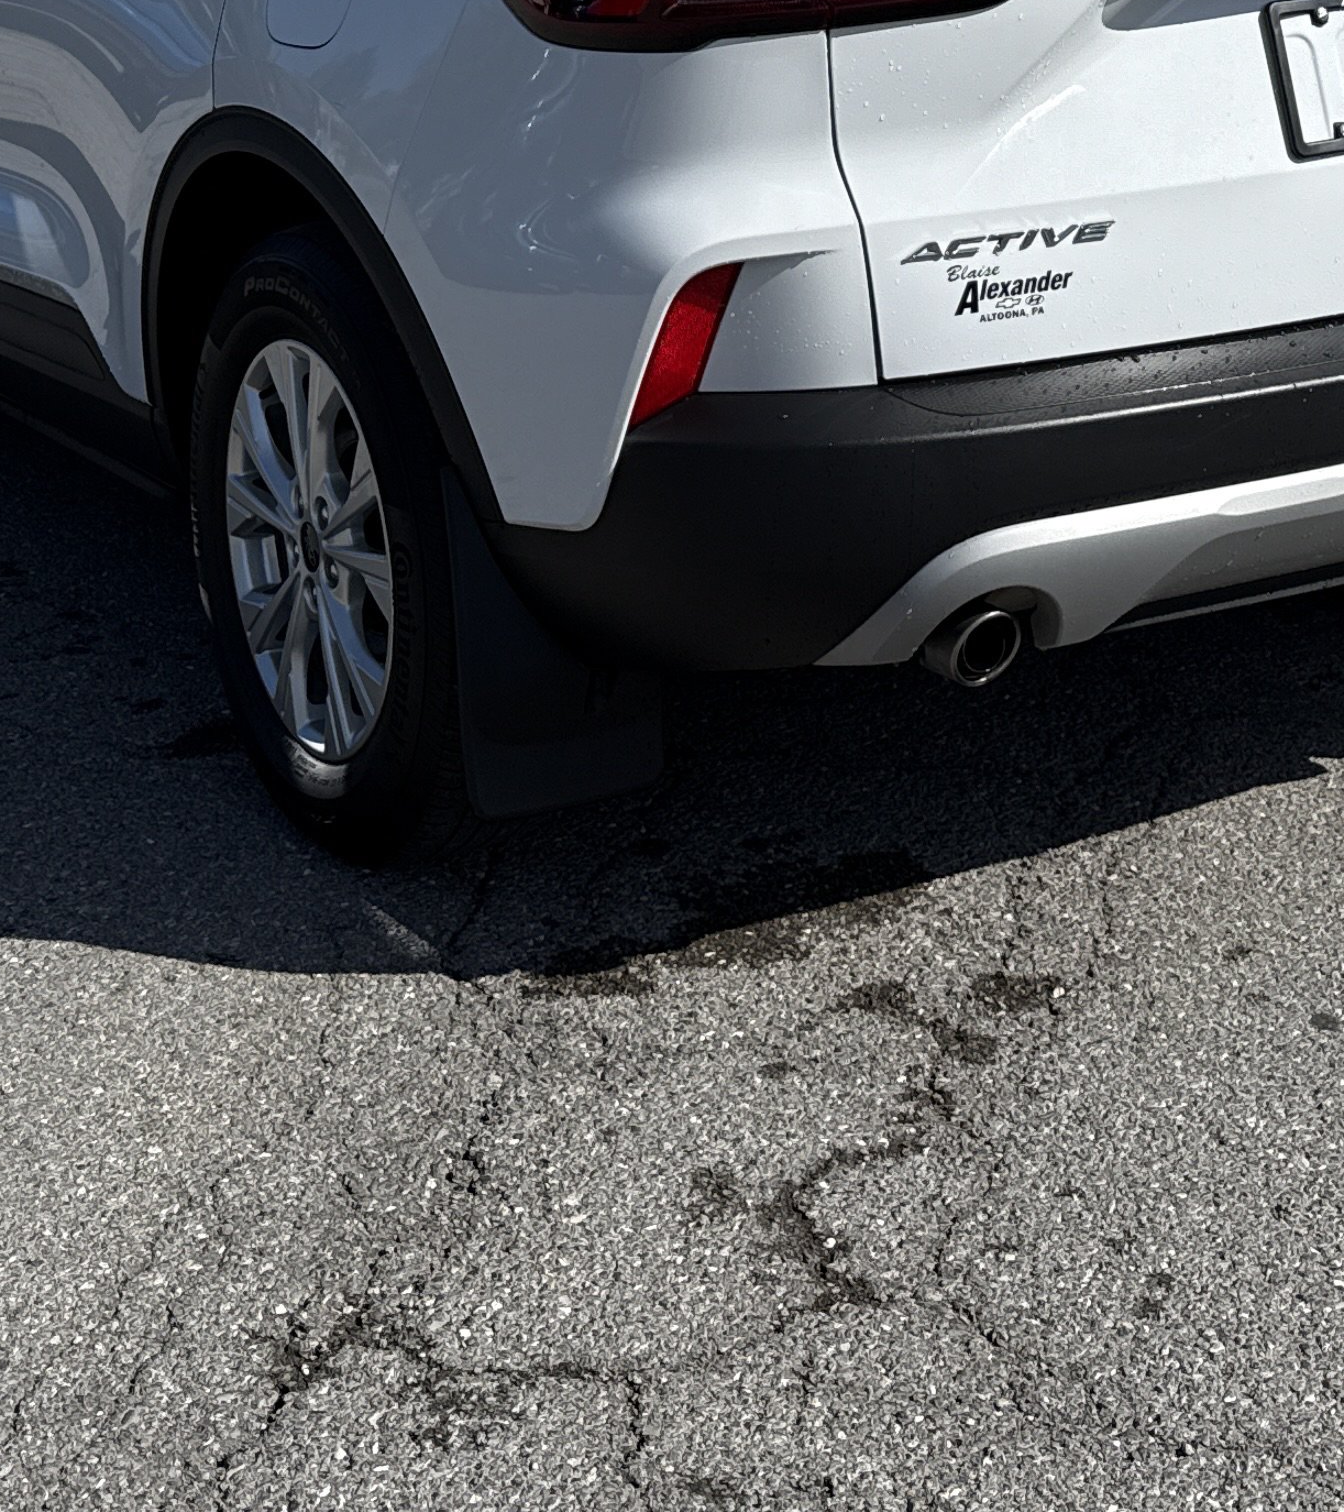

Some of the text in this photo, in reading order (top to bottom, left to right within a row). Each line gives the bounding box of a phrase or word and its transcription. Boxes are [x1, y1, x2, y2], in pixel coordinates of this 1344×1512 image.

[900, 220, 1116, 266] ACTIVE
[946, 264, 1001, 283] Blaise
[955, 270, 1074, 317] Alexander
[1031, 306, 1045, 317] PA
